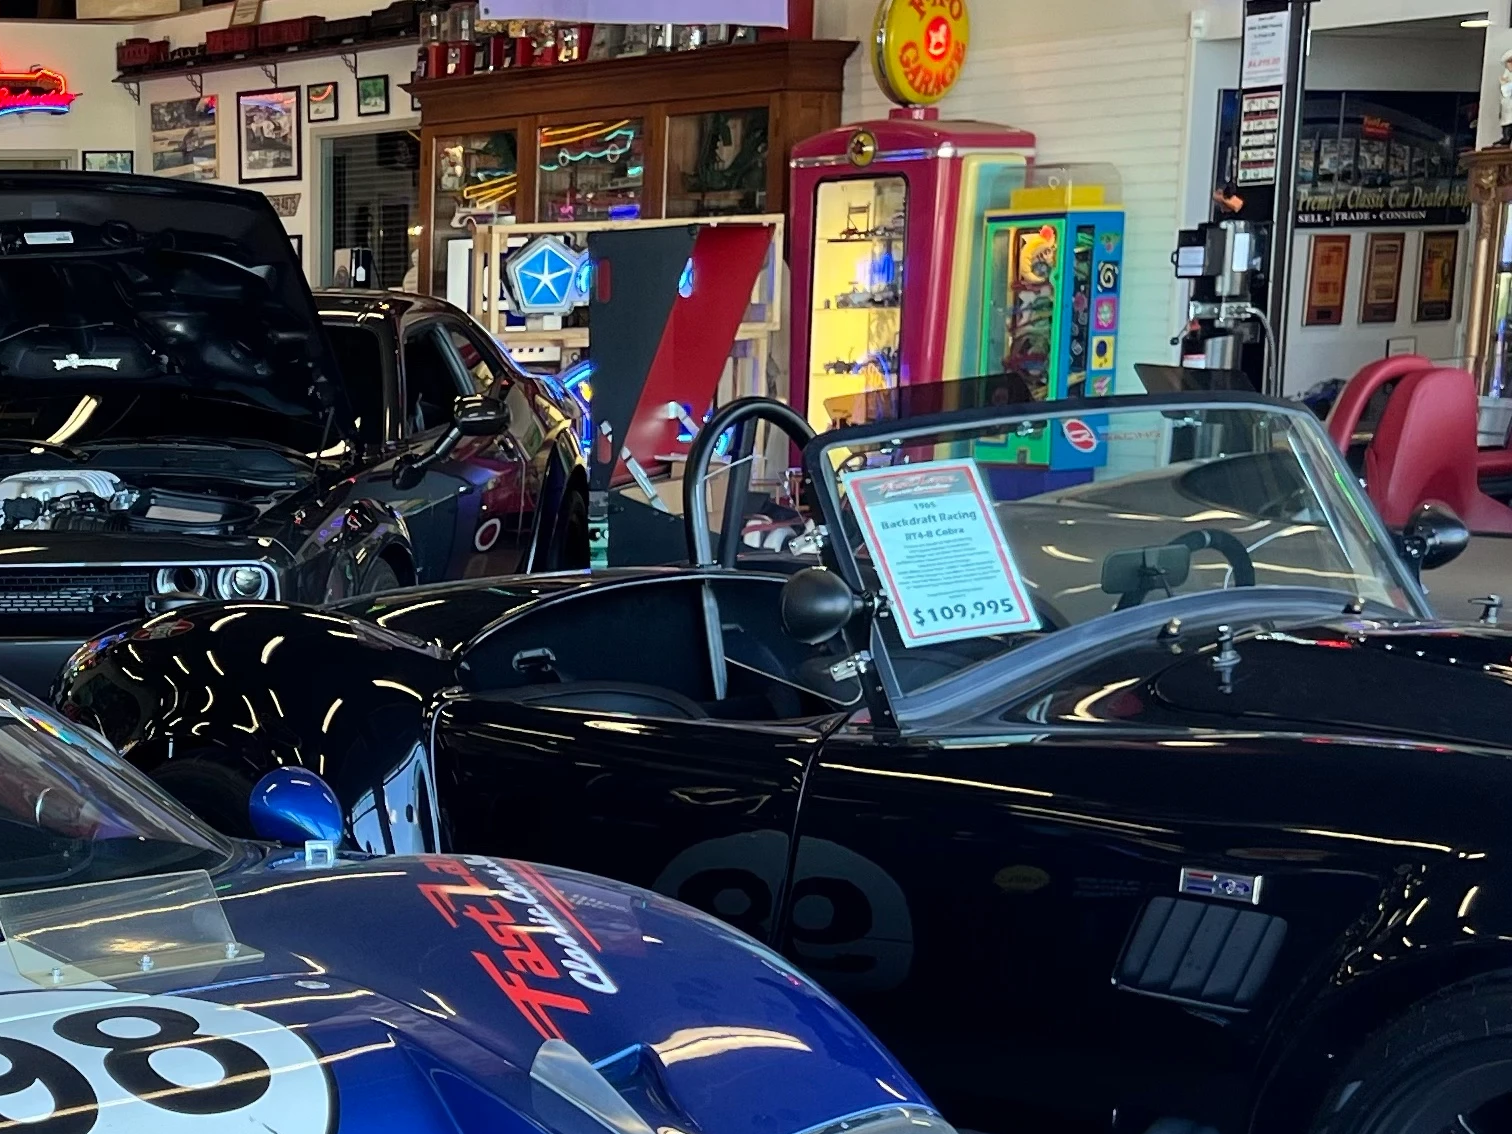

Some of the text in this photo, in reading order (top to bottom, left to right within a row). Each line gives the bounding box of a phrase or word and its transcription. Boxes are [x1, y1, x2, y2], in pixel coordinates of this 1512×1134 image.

[899, 40, 966, 97] GARAGE
[1297, 186, 1343, 212] Premier
[1347, 186, 1385, 209] Classic
[1388, 186, 1409, 209] Car
[1298, 210, 1427, 224] SELL TRADE CONSIGN
[913, 501, 937, 511] 1965
[880, 511, 977, 530] Backdraft Racing
[936, 526, 965, 537] Cobra
[913, 597, 1014, 627] $109,995
[417, 856, 590, 1041] Fast La
[526, 902, 619, 994] Classic
